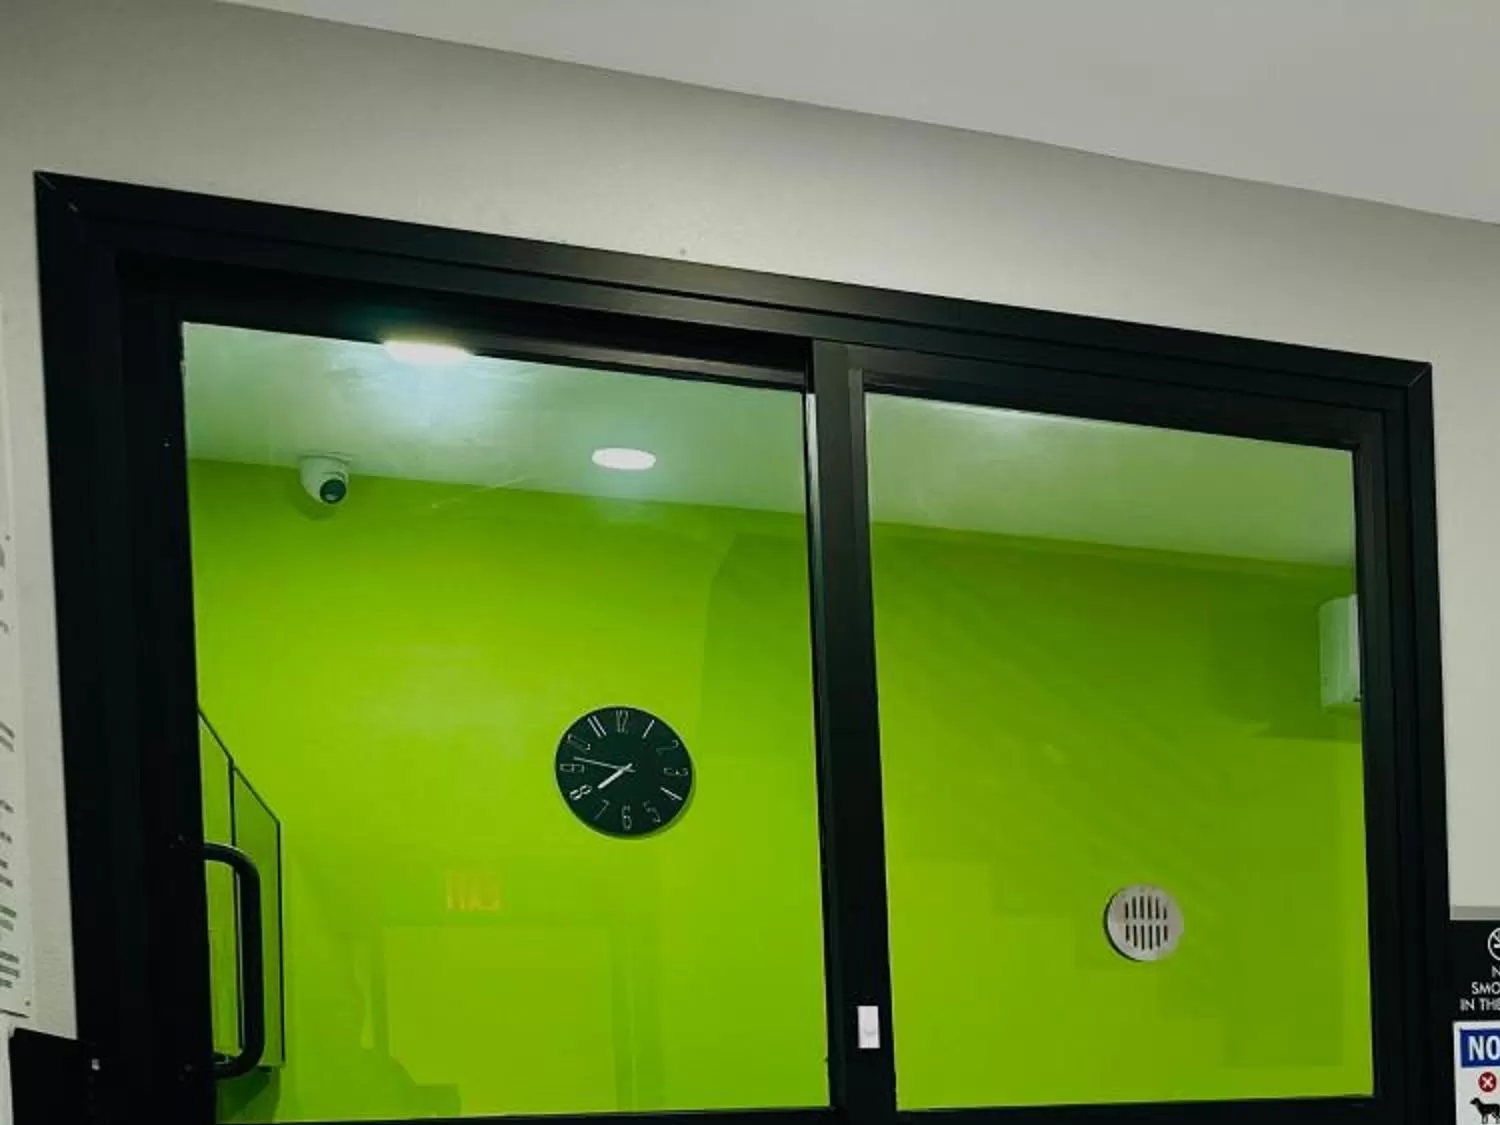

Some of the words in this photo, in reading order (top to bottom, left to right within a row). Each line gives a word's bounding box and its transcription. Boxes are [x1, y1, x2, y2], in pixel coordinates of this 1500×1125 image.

[569, 784, 593, 800] 8
[621, 805, 633, 831] 6
[1460, 998, 1475, 1011] IN
